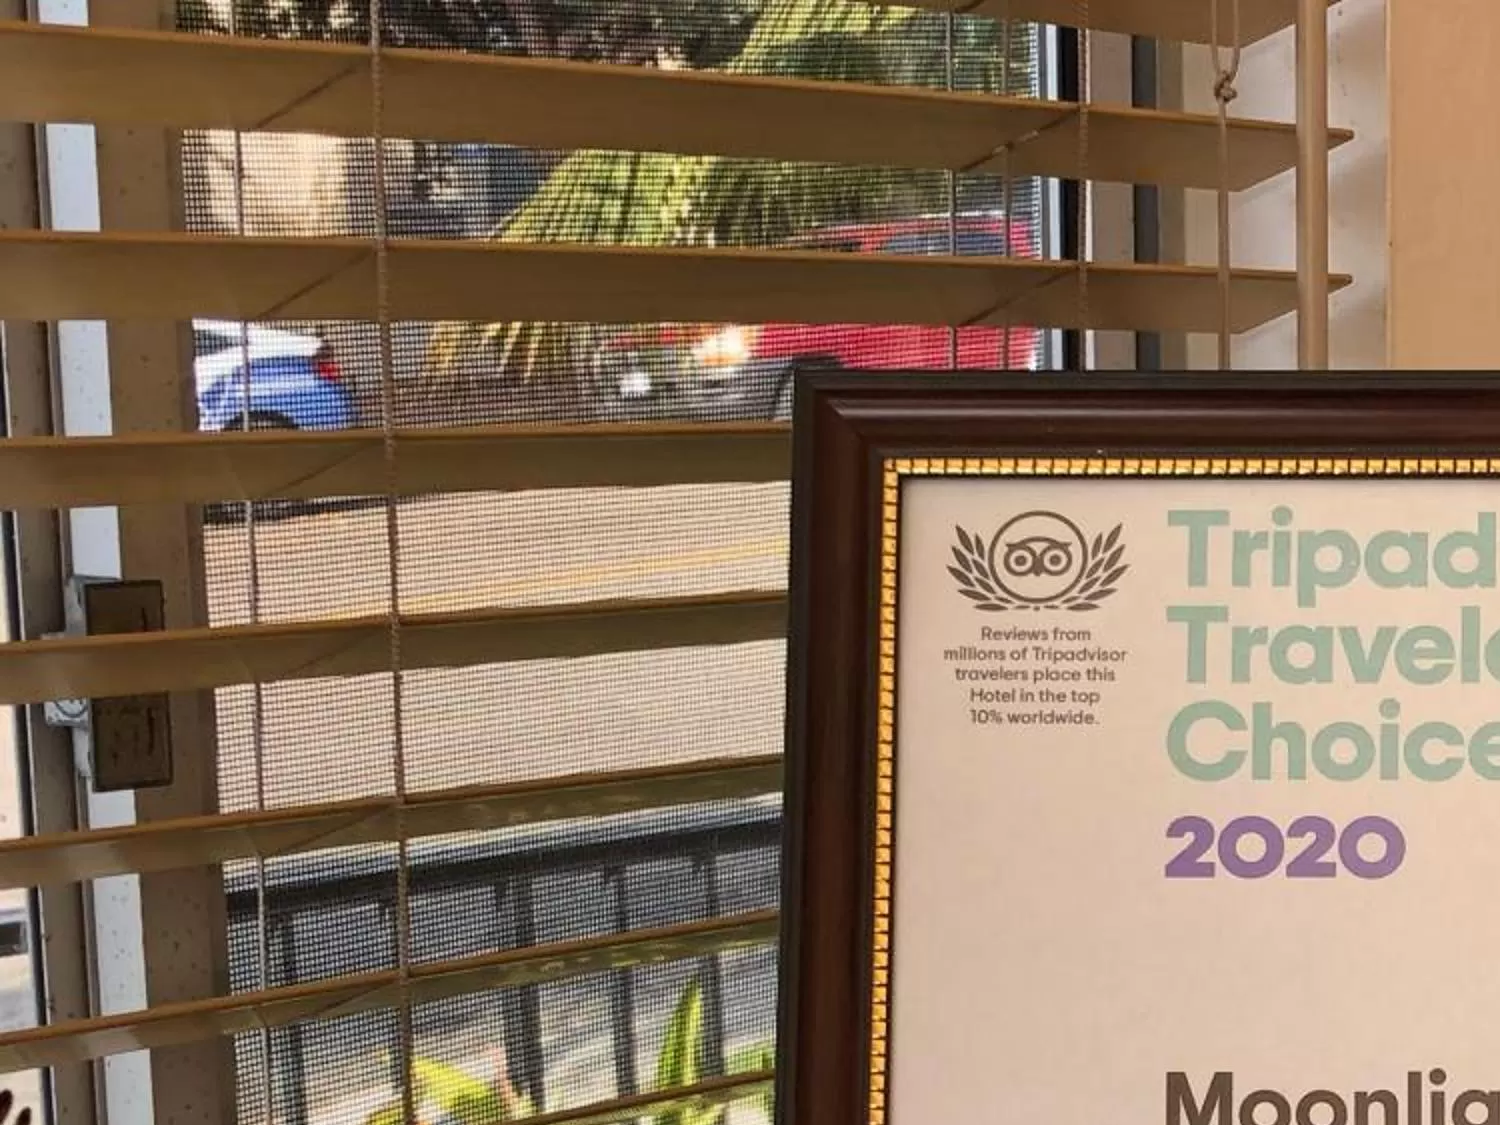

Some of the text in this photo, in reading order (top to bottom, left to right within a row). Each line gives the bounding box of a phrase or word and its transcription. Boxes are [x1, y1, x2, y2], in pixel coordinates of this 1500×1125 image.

[981, 626, 1091, 641] Reviews from
[944, 646, 1127, 664] millions of Tripadvisor
[955, 666, 1115, 684] travelers place this
[970, 688, 1100, 706] Hotel in the top
[970, 709, 1099, 724] 10% worldwide.
[1164, 815, 1407, 879] 2020
